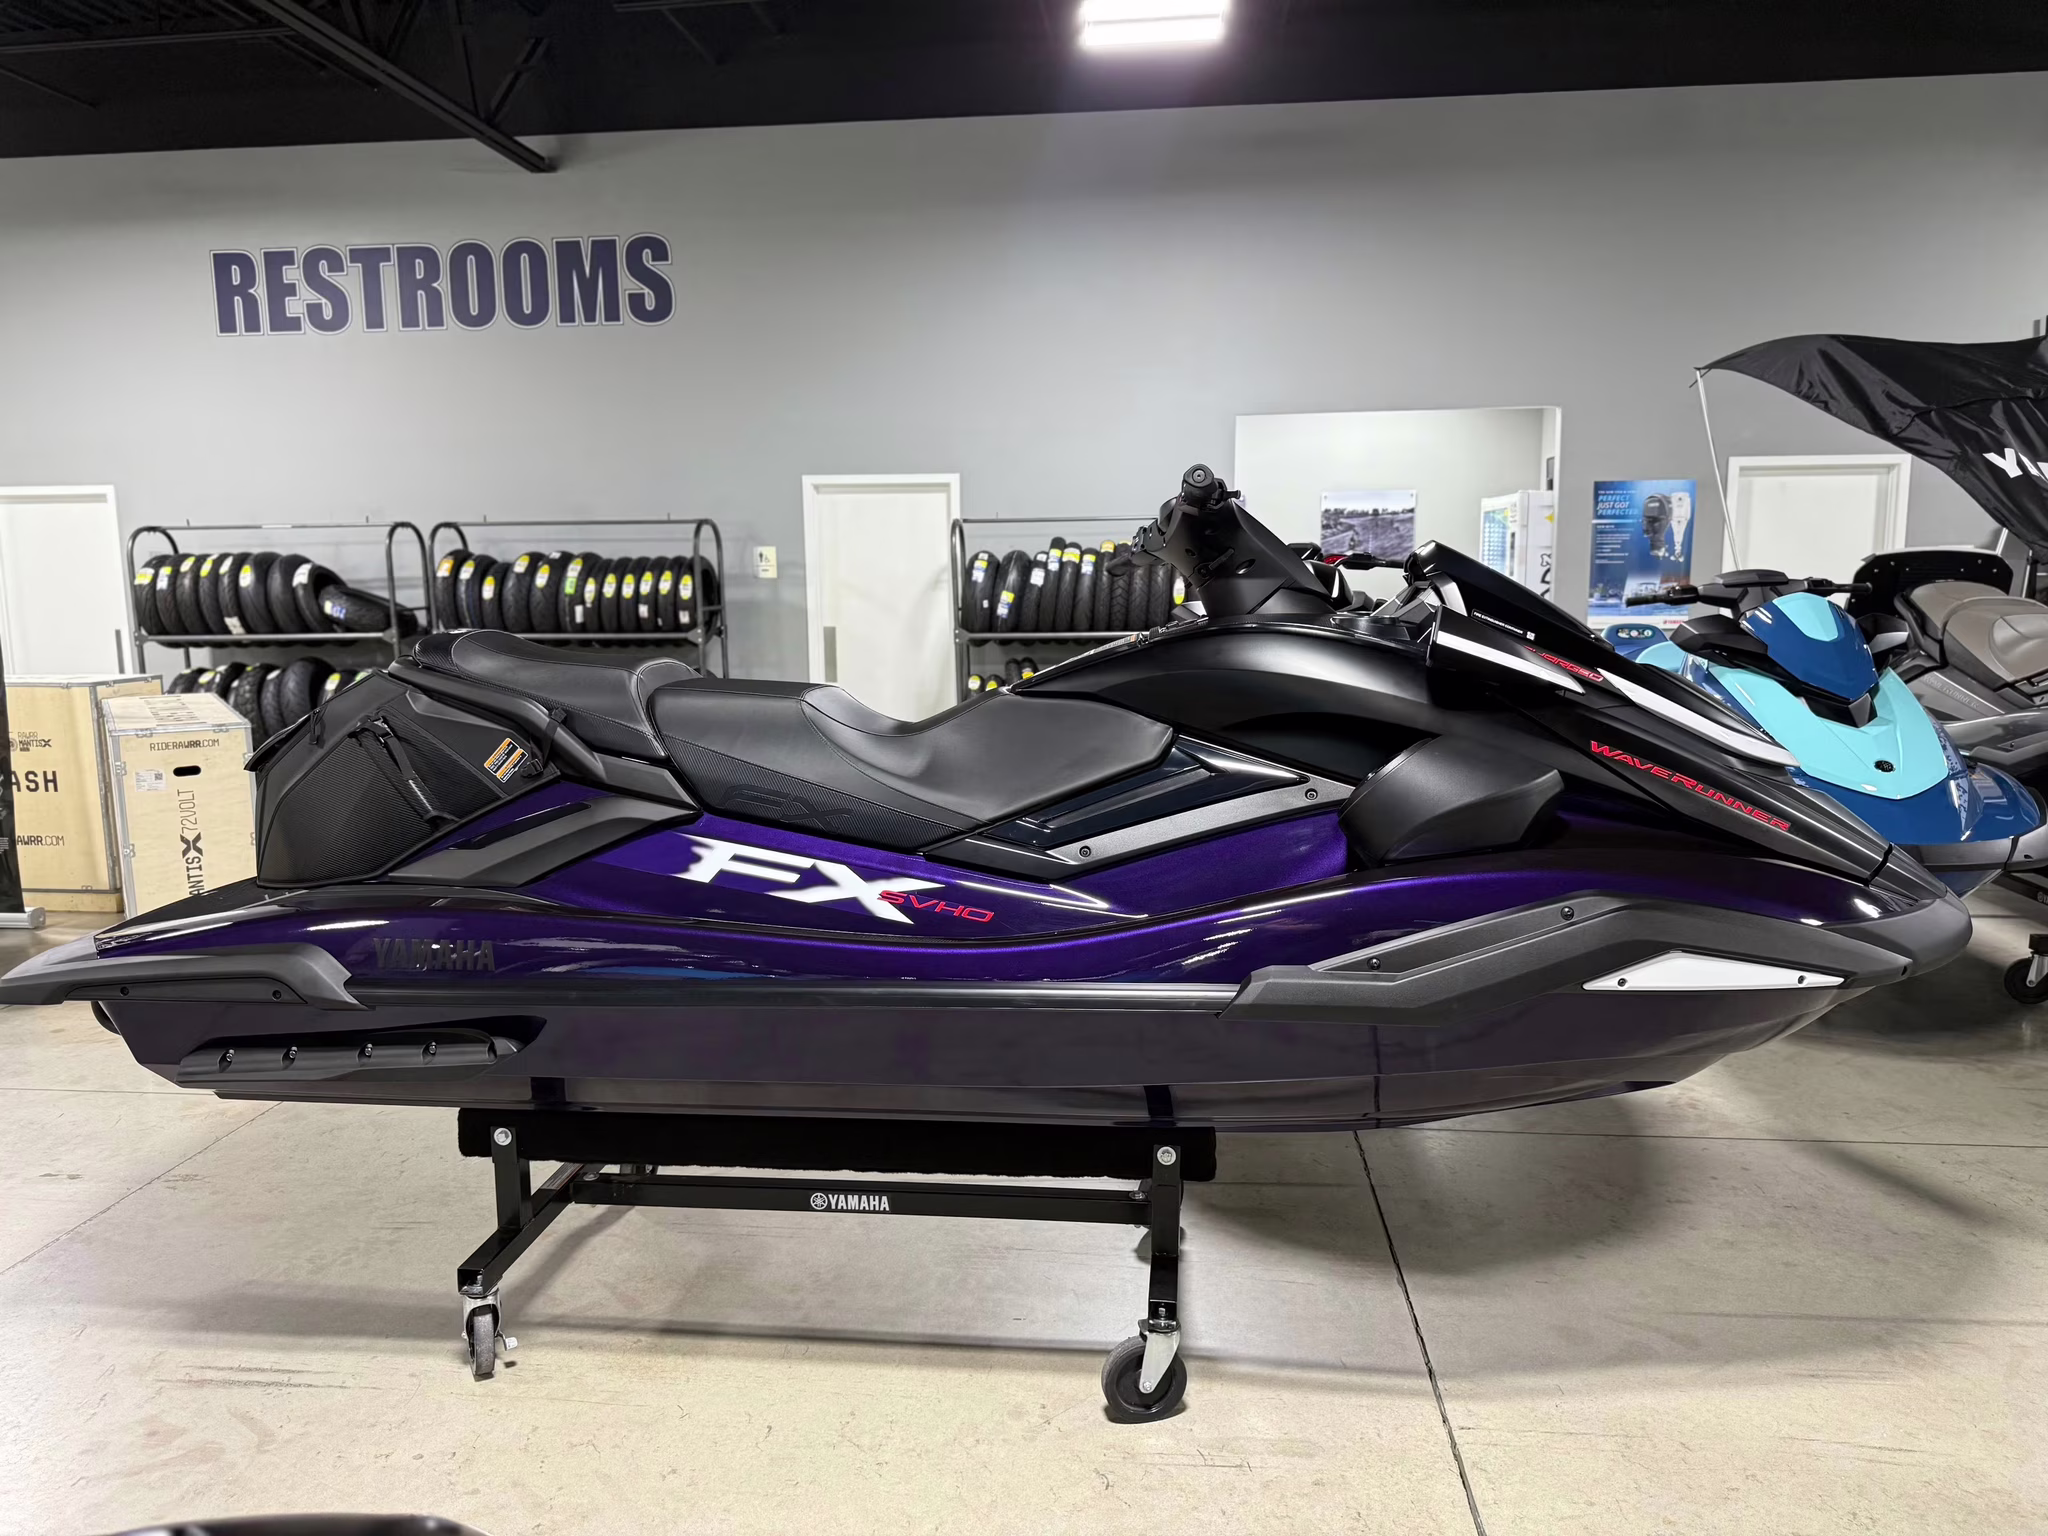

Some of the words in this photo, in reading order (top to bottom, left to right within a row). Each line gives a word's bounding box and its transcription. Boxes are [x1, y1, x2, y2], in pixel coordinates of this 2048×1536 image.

[210, 233, 676, 336] RESTROOMS
[1596, 501, 1615, 510] JUST
[1614, 501, 1630, 509] GOT
[149, 738, 220, 752] RIDERAWRR.COM
[1590, 740, 1792, 832] WAVERUNNER
[667, 830, 947, 925] FX
[877, 890, 995, 923] SVHO
[373, 937, 496, 972] YAMAHA
[828, 1194, 890, 1211] YAMAHA
